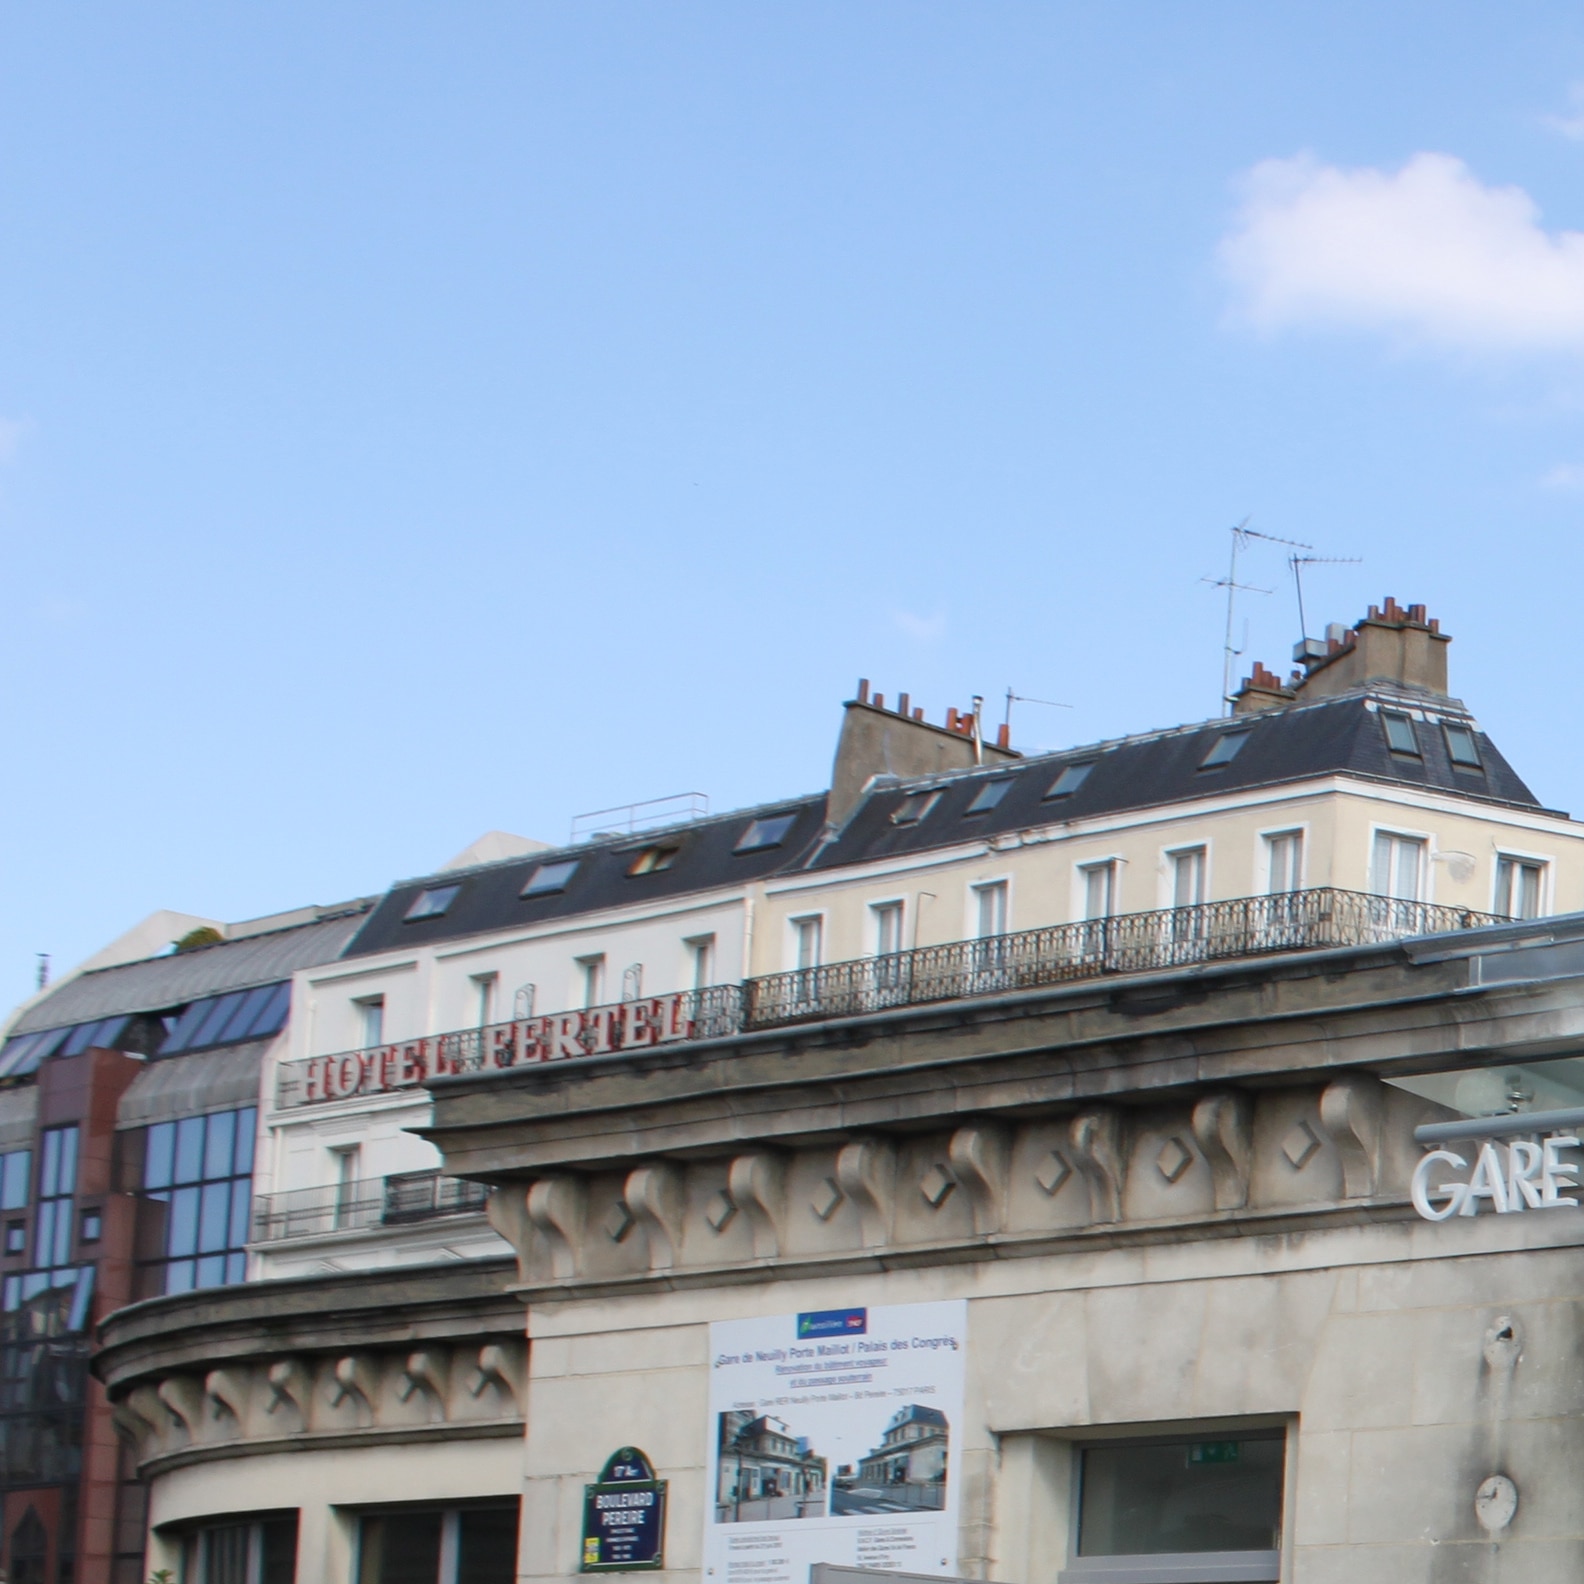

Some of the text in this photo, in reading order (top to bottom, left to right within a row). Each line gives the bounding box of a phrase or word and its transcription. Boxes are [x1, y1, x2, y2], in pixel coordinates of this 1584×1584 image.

[302, 995, 696, 1101] HOTEL FERTEL
[1411, 1135, 1581, 1222] GARE
[789, 1347, 815, 1359] Porte
[857, 1340, 888, 1353] Palais
[890, 1338, 909, 1351] des
[596, 1491, 654, 1509] BOULEVARD
[601, 1509, 646, 1526] PEREIRE
